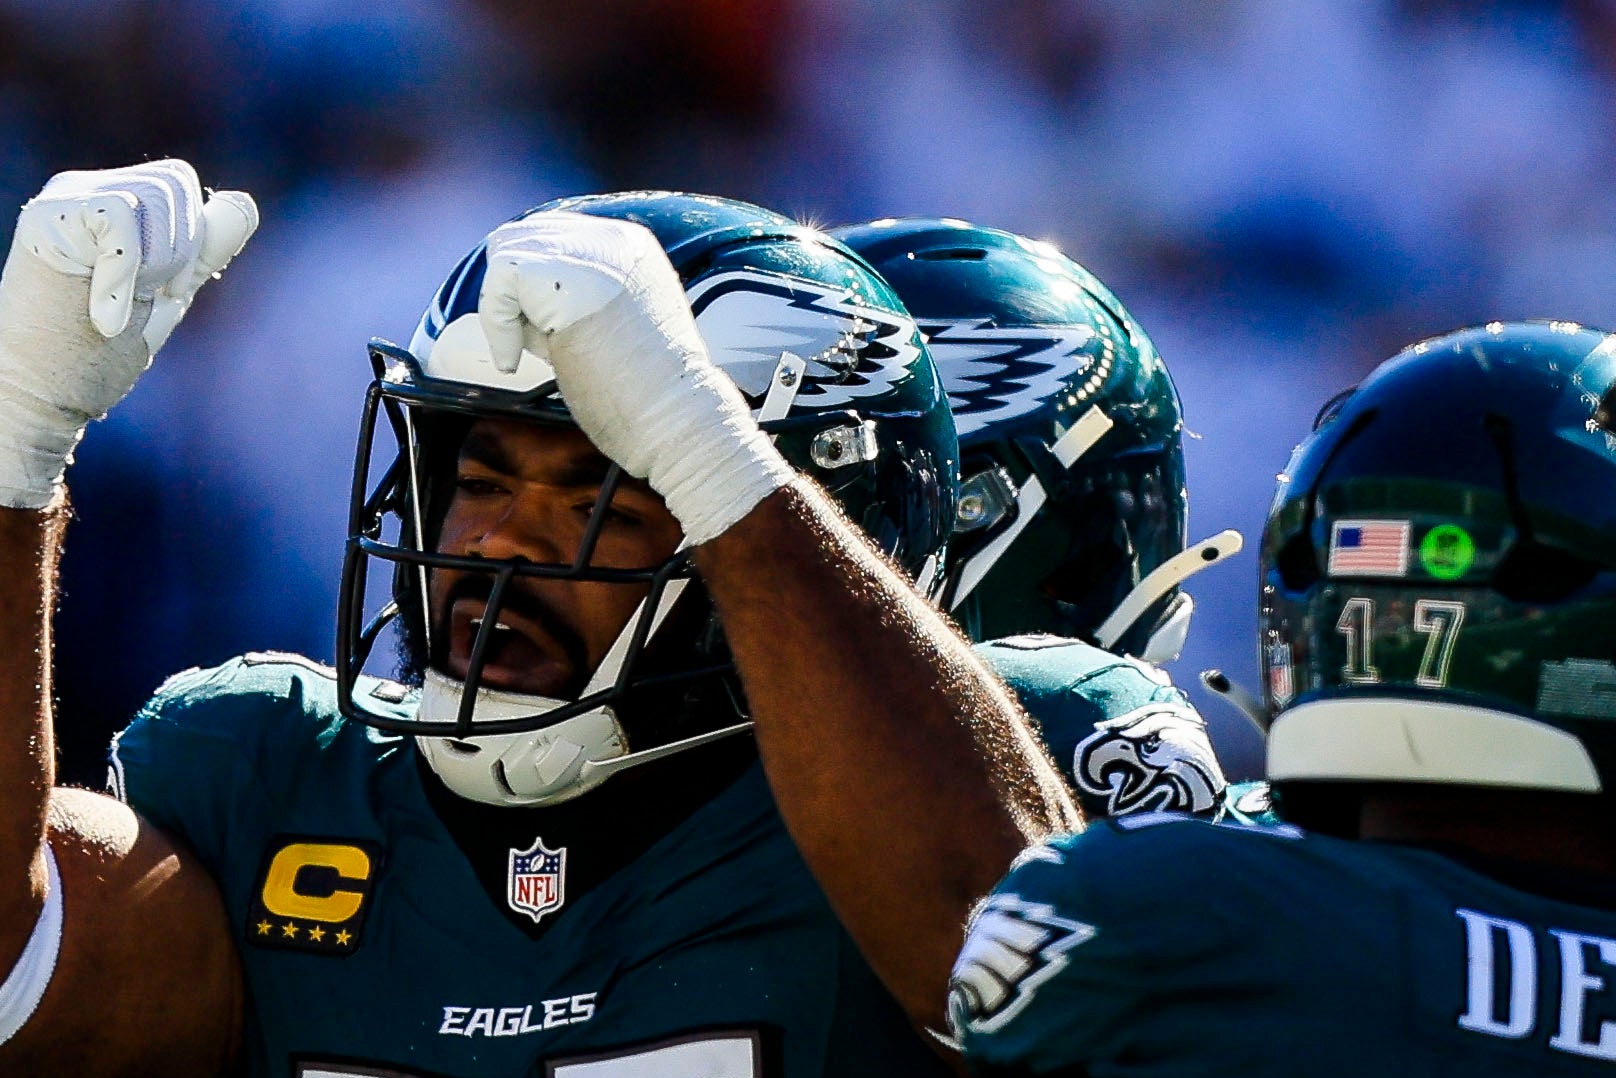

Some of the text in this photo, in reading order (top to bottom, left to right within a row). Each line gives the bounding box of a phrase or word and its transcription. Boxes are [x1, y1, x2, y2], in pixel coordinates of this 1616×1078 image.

[1336, 597, 1465, 688] 17
[263, 843, 370, 922] C
[517, 876, 555, 904] NFL
[439, 992, 597, 1036] EAGLES
